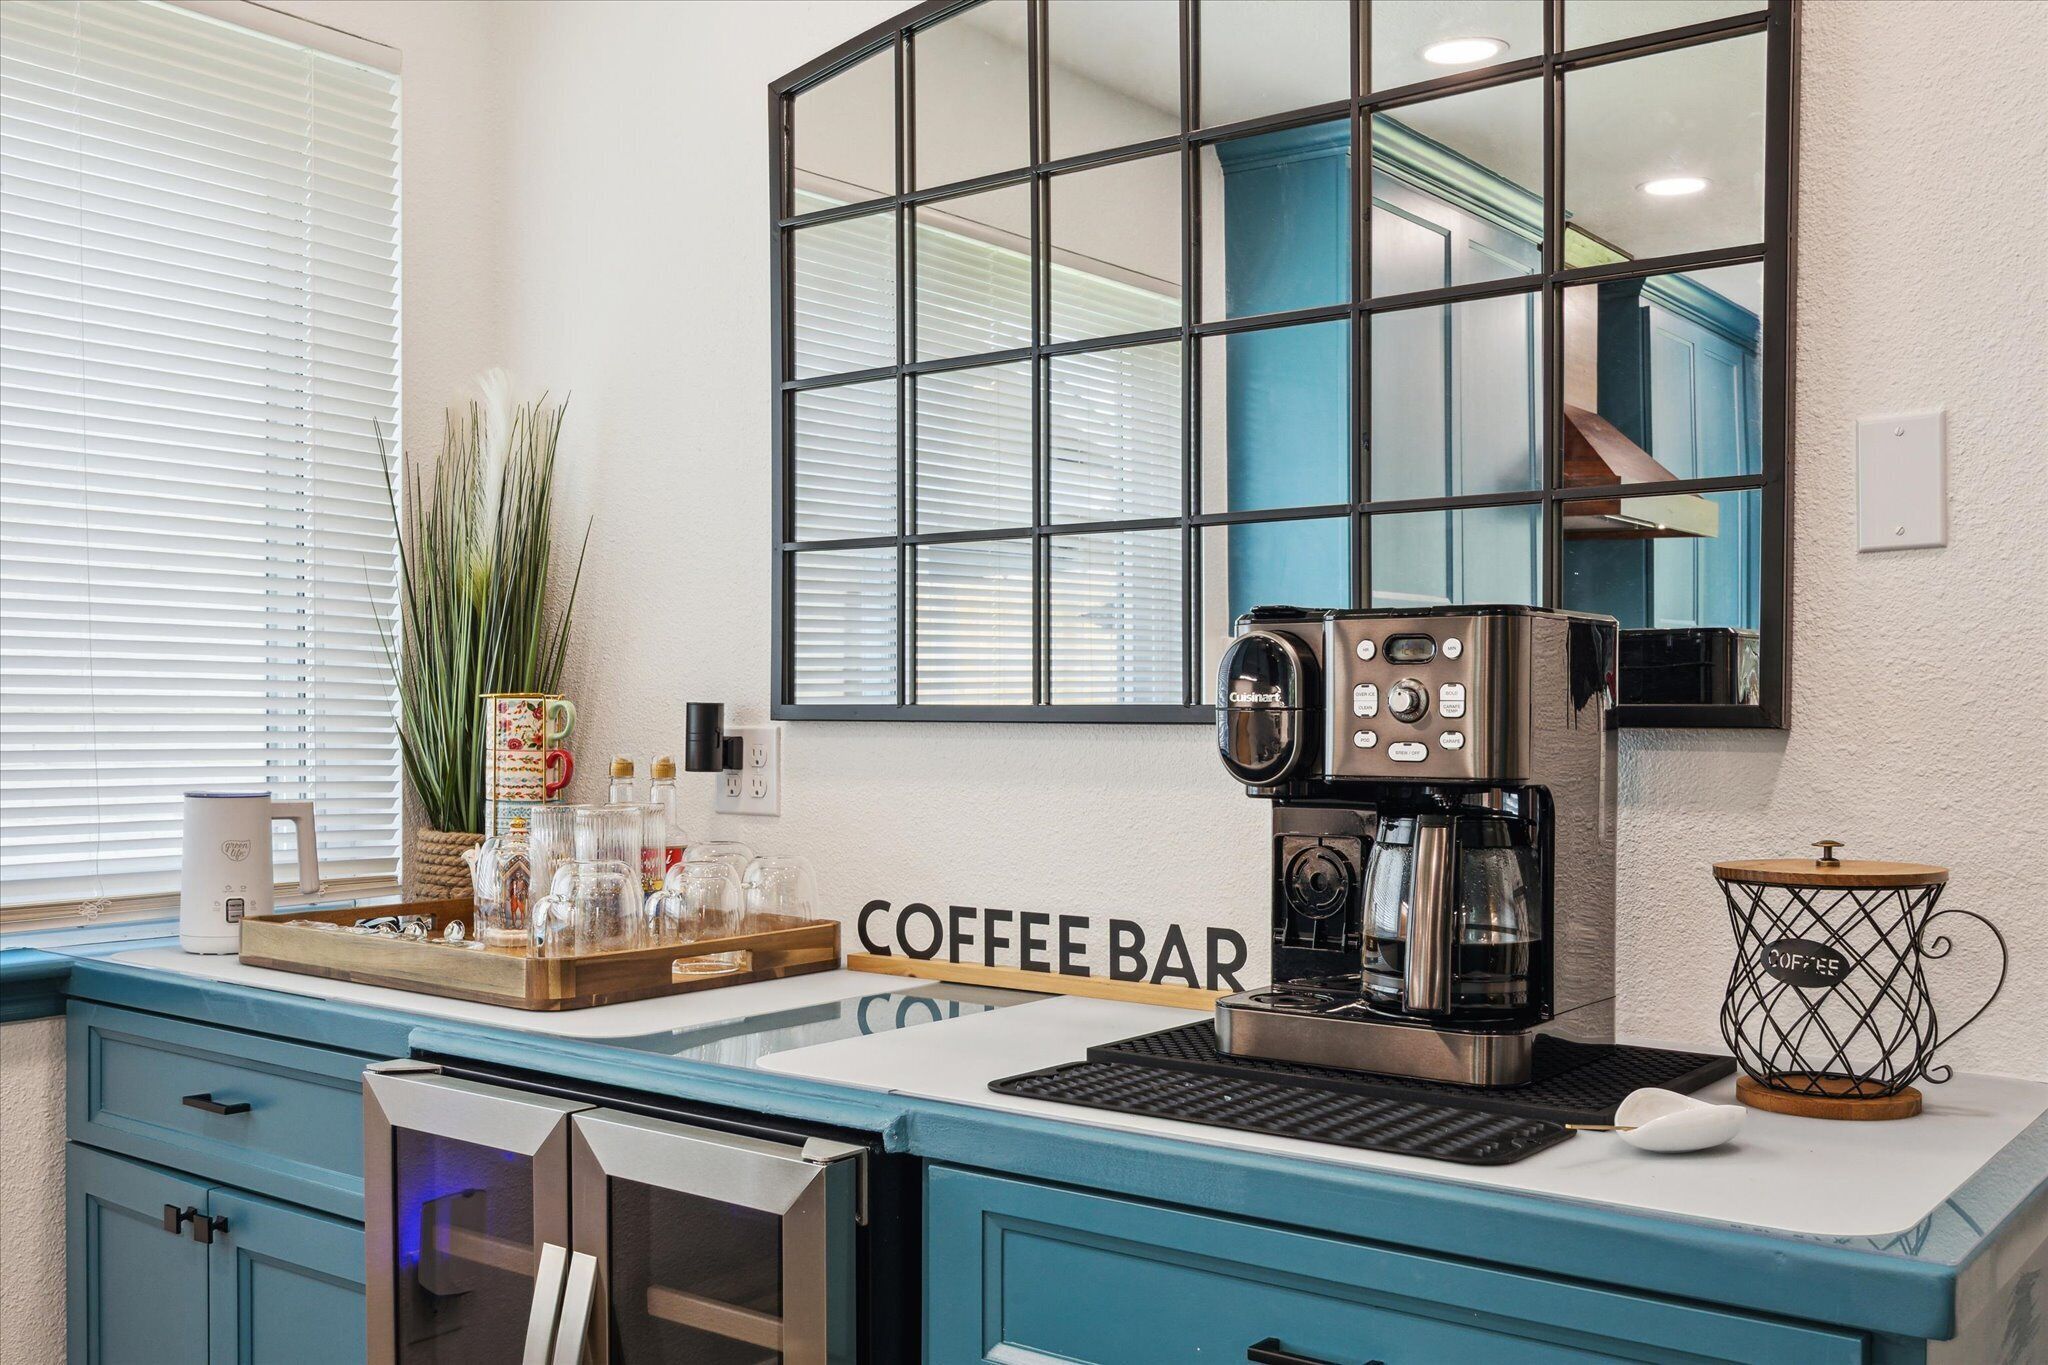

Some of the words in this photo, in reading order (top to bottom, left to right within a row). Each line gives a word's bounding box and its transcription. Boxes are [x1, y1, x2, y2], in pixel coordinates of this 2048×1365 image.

[1229, 691, 1281, 703] Cuisinart
[857, 899, 1091, 977] COFFEE
[1109, 918, 1248, 992] BAR
